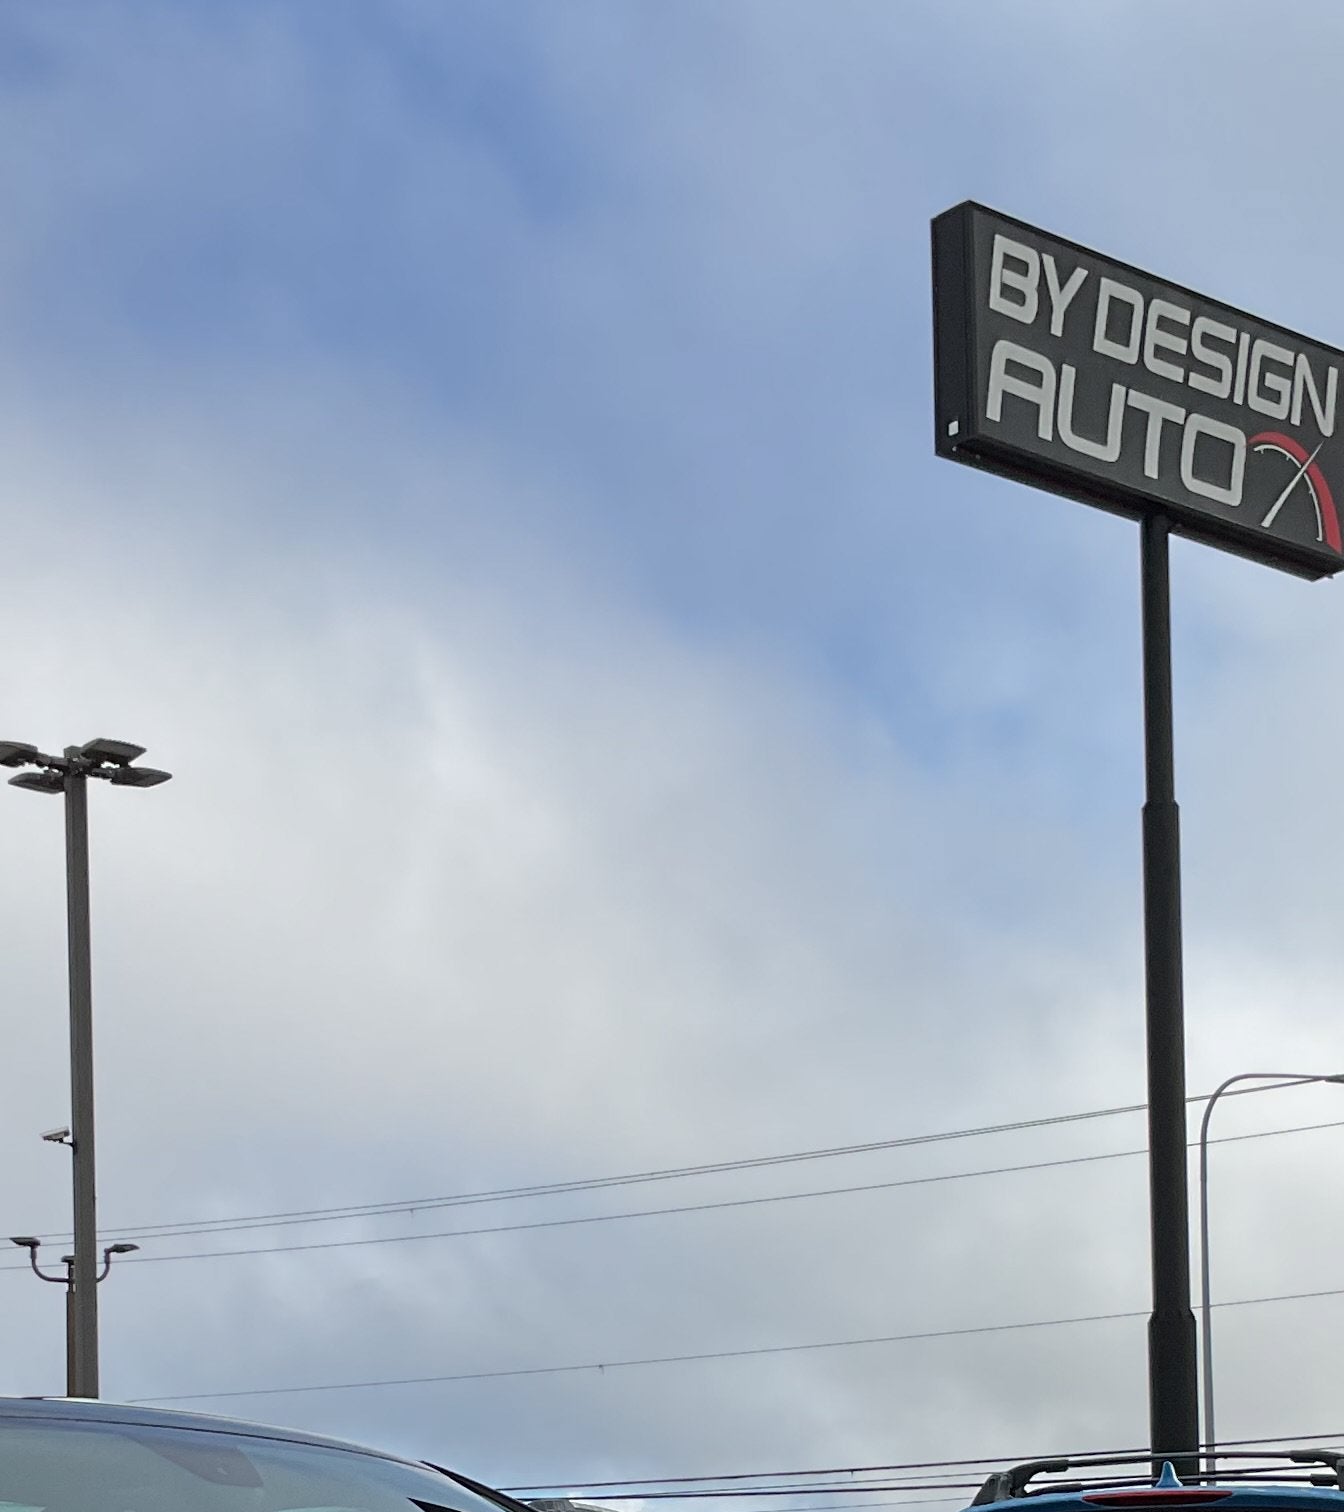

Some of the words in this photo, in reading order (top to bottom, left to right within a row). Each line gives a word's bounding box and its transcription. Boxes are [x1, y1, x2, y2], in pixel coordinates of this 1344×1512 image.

[986, 339, 1246, 506] AUTO
[989, 234, 1088, 338] BY
[1093, 277, 1338, 437] DESIGN
